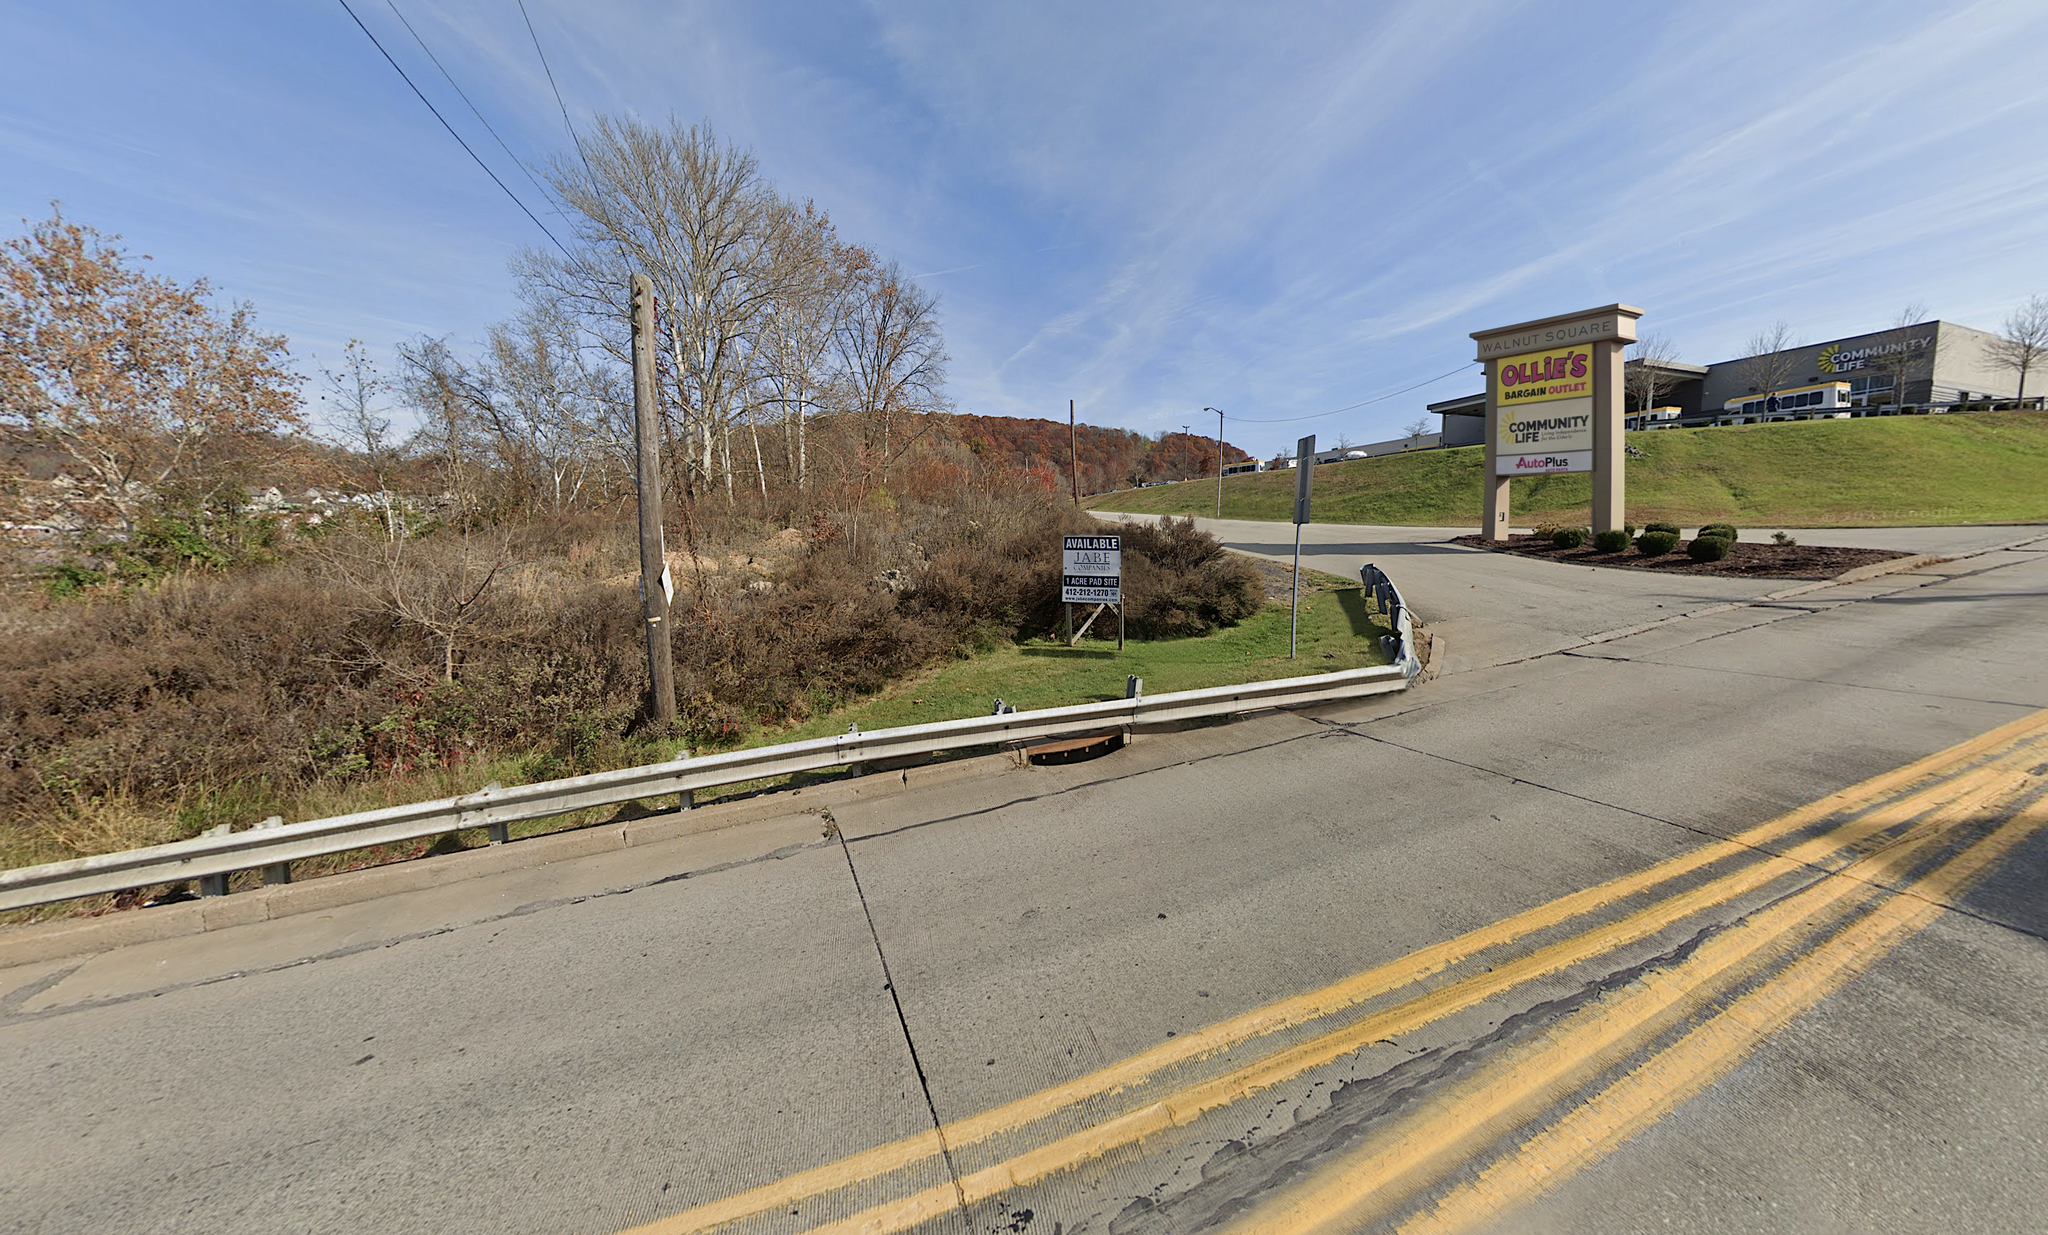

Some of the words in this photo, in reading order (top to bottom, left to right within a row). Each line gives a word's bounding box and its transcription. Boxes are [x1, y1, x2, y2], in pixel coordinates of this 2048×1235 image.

[1483, 334, 1540, 353] WALNUT
[1545, 321, 1611, 342] SQUARE
[1830, 336, 1932, 363] COMMUNITY
[1835, 360, 1865, 372] LIFE
[1505, 387, 1547, 400] BARGAIN
[1548, 382, 1587, 395] OUTLET
[1509, 415, 1589, 433] COMMUNITY
[1515, 431, 1539, 443] LIFE
[1515, 456, 1568, 469] AutoPlus
[1066, 538, 1117, 549] AVAILABLE
[1074, 552, 1110, 562] JABE
[1066, 577, 1069, 585] 1
[1071, 577, 1088, 585] ACRE
[1089, 578, 1102, 586] PAD
[1103, 578, 1117, 586] SITE
[1065, 588, 1109, 597] 412-212-1270
